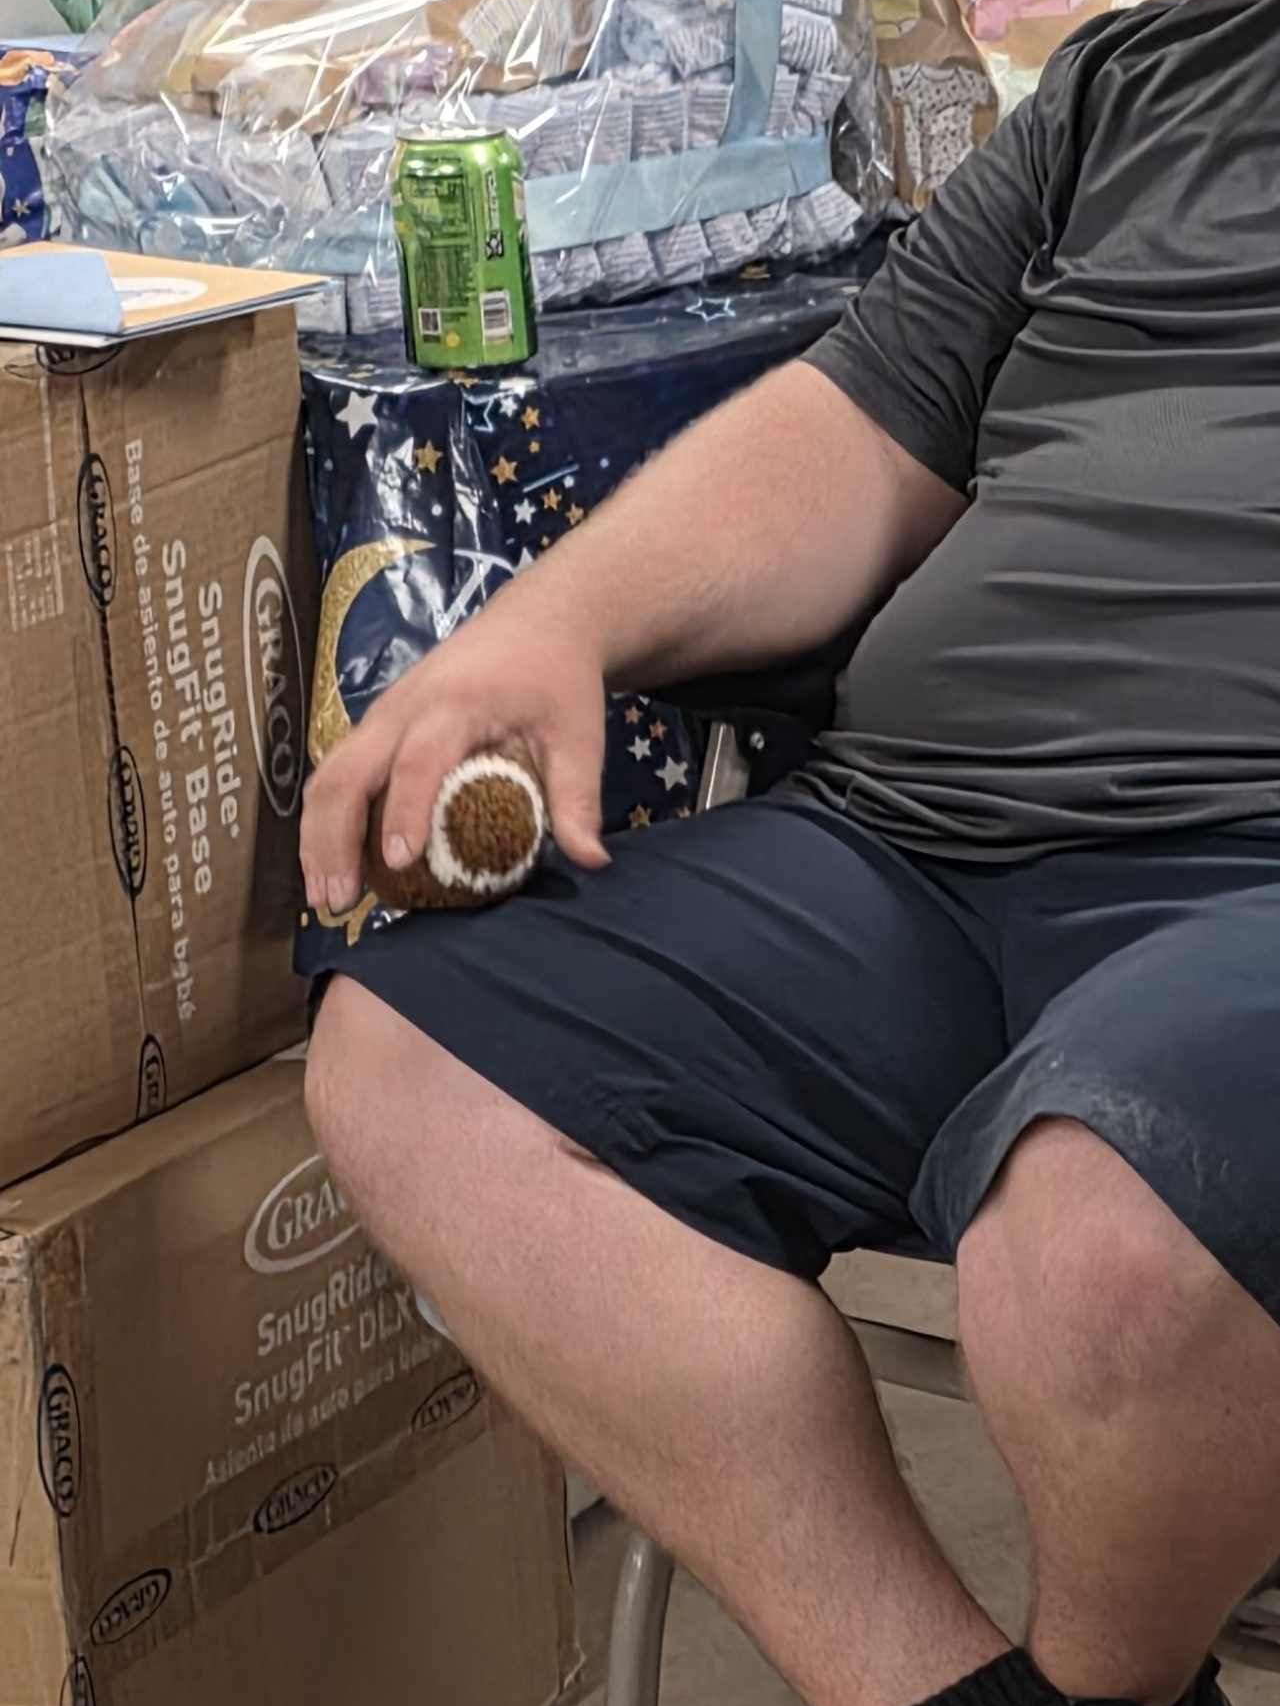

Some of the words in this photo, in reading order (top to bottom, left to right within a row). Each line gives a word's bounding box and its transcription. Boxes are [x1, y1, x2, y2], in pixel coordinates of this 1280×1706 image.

[125, 439, 143, 526] Base
[132, 533, 149, 576] de
[138, 586, 161, 711] asiento
[255, 577, 295, 786] GRACO
[153, 719, 172, 761] de
[163, 539, 202, 743] SnugFit
[186, 765, 212, 894] Base
[199, 581, 241, 827] SnugRide
[159, 769, 179, 844] auto
[163, 854, 184, 930] para
[267, 1179, 346, 1250] GRA
[235, 1338, 343, 1424] SnugFit
